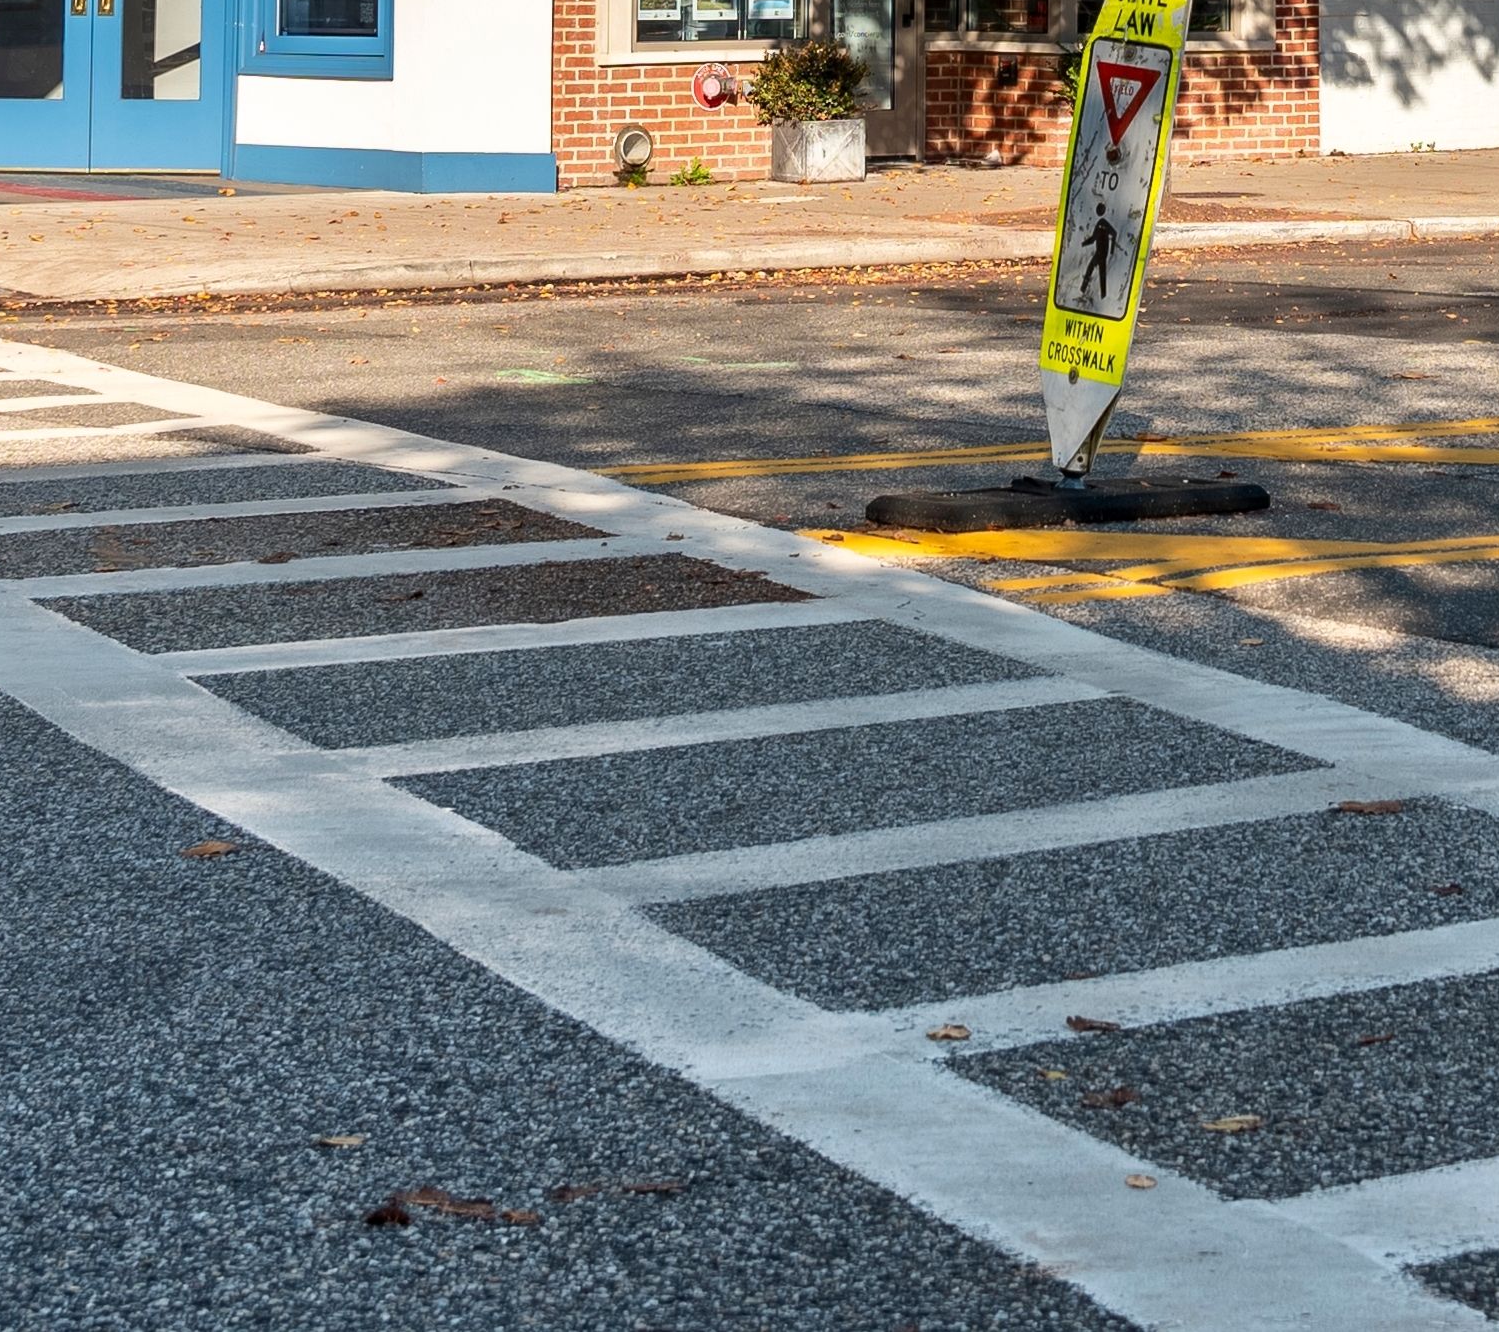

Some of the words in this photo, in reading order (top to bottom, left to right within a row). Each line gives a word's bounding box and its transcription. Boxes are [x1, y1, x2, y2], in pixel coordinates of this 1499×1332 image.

[1113, 8, 1156, 37] LAW
[1113, 83, 1134, 97] YIELD
[1100, 171, 1119, 191] TO
[1065, 318, 1104, 344] WITHIN
[1048, 340, 1116, 374] CROSSWALK
